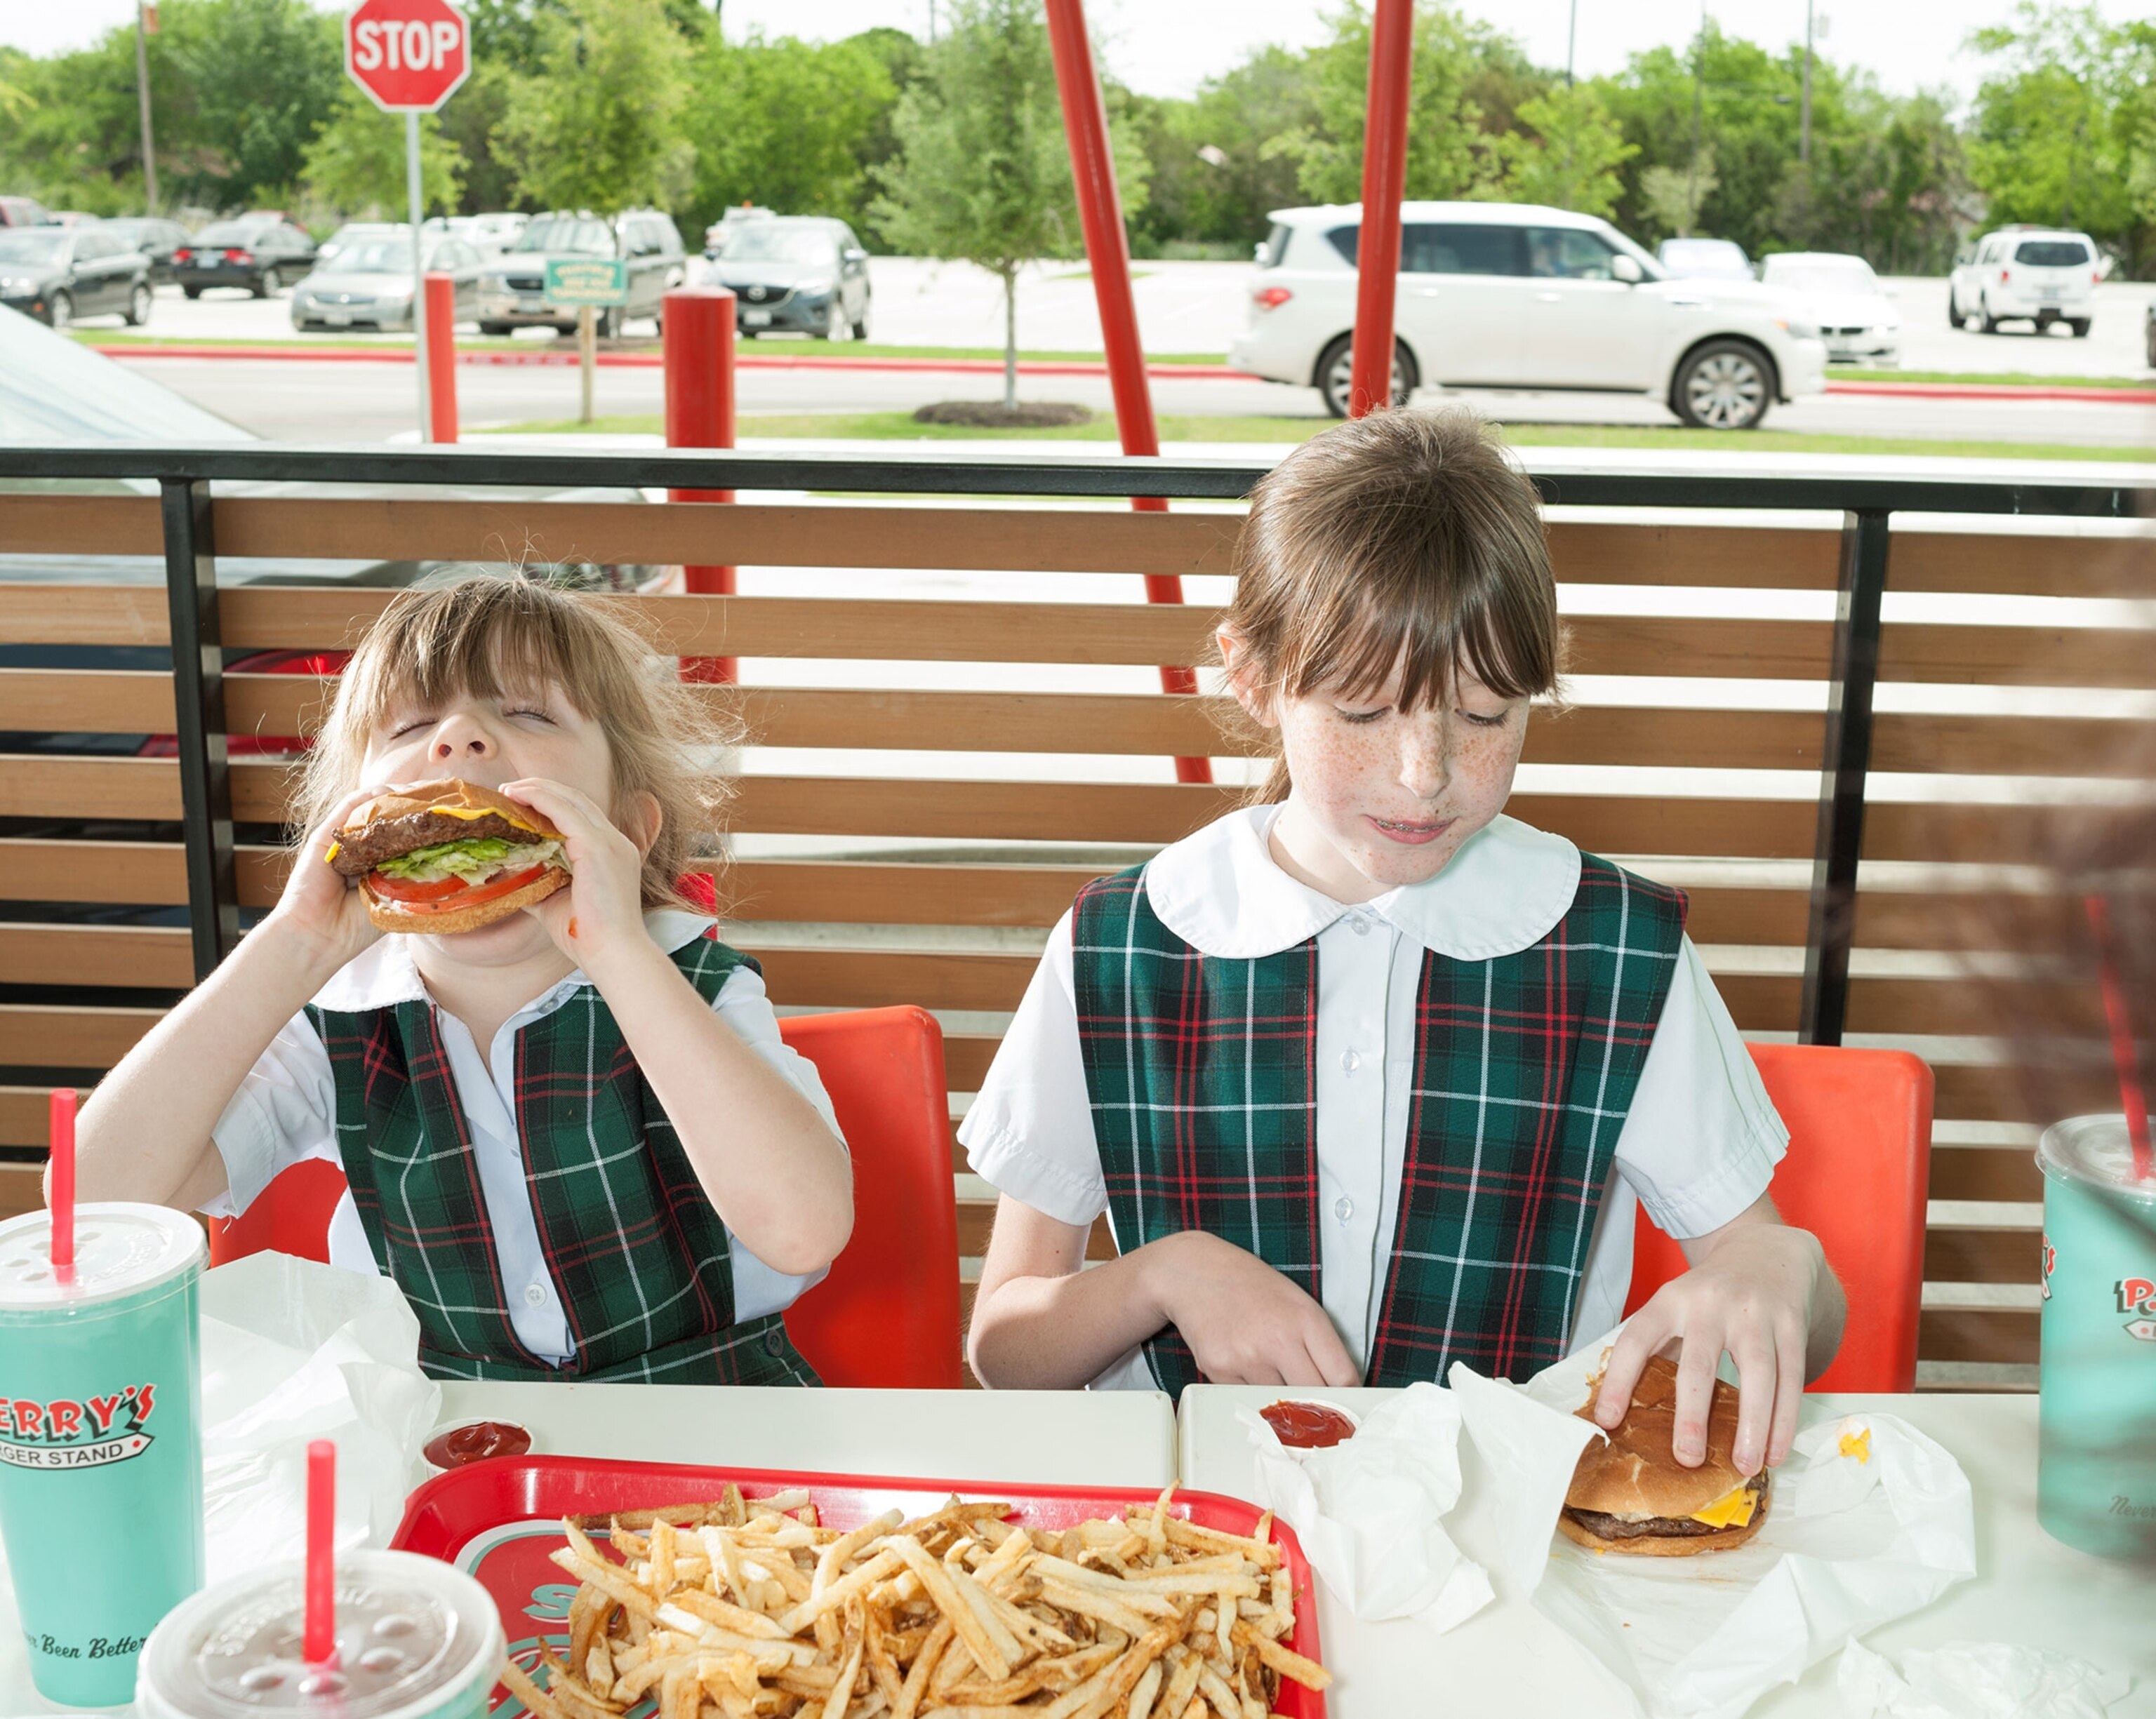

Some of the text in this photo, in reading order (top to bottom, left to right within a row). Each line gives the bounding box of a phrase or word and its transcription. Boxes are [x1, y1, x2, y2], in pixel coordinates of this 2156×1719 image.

[355, 20, 460, 71] STOP
[0, 1443, 124, 1465] GER STAND
[41, 1633, 81, 1658] Been
[88, 1636, 147, 1659] Better
